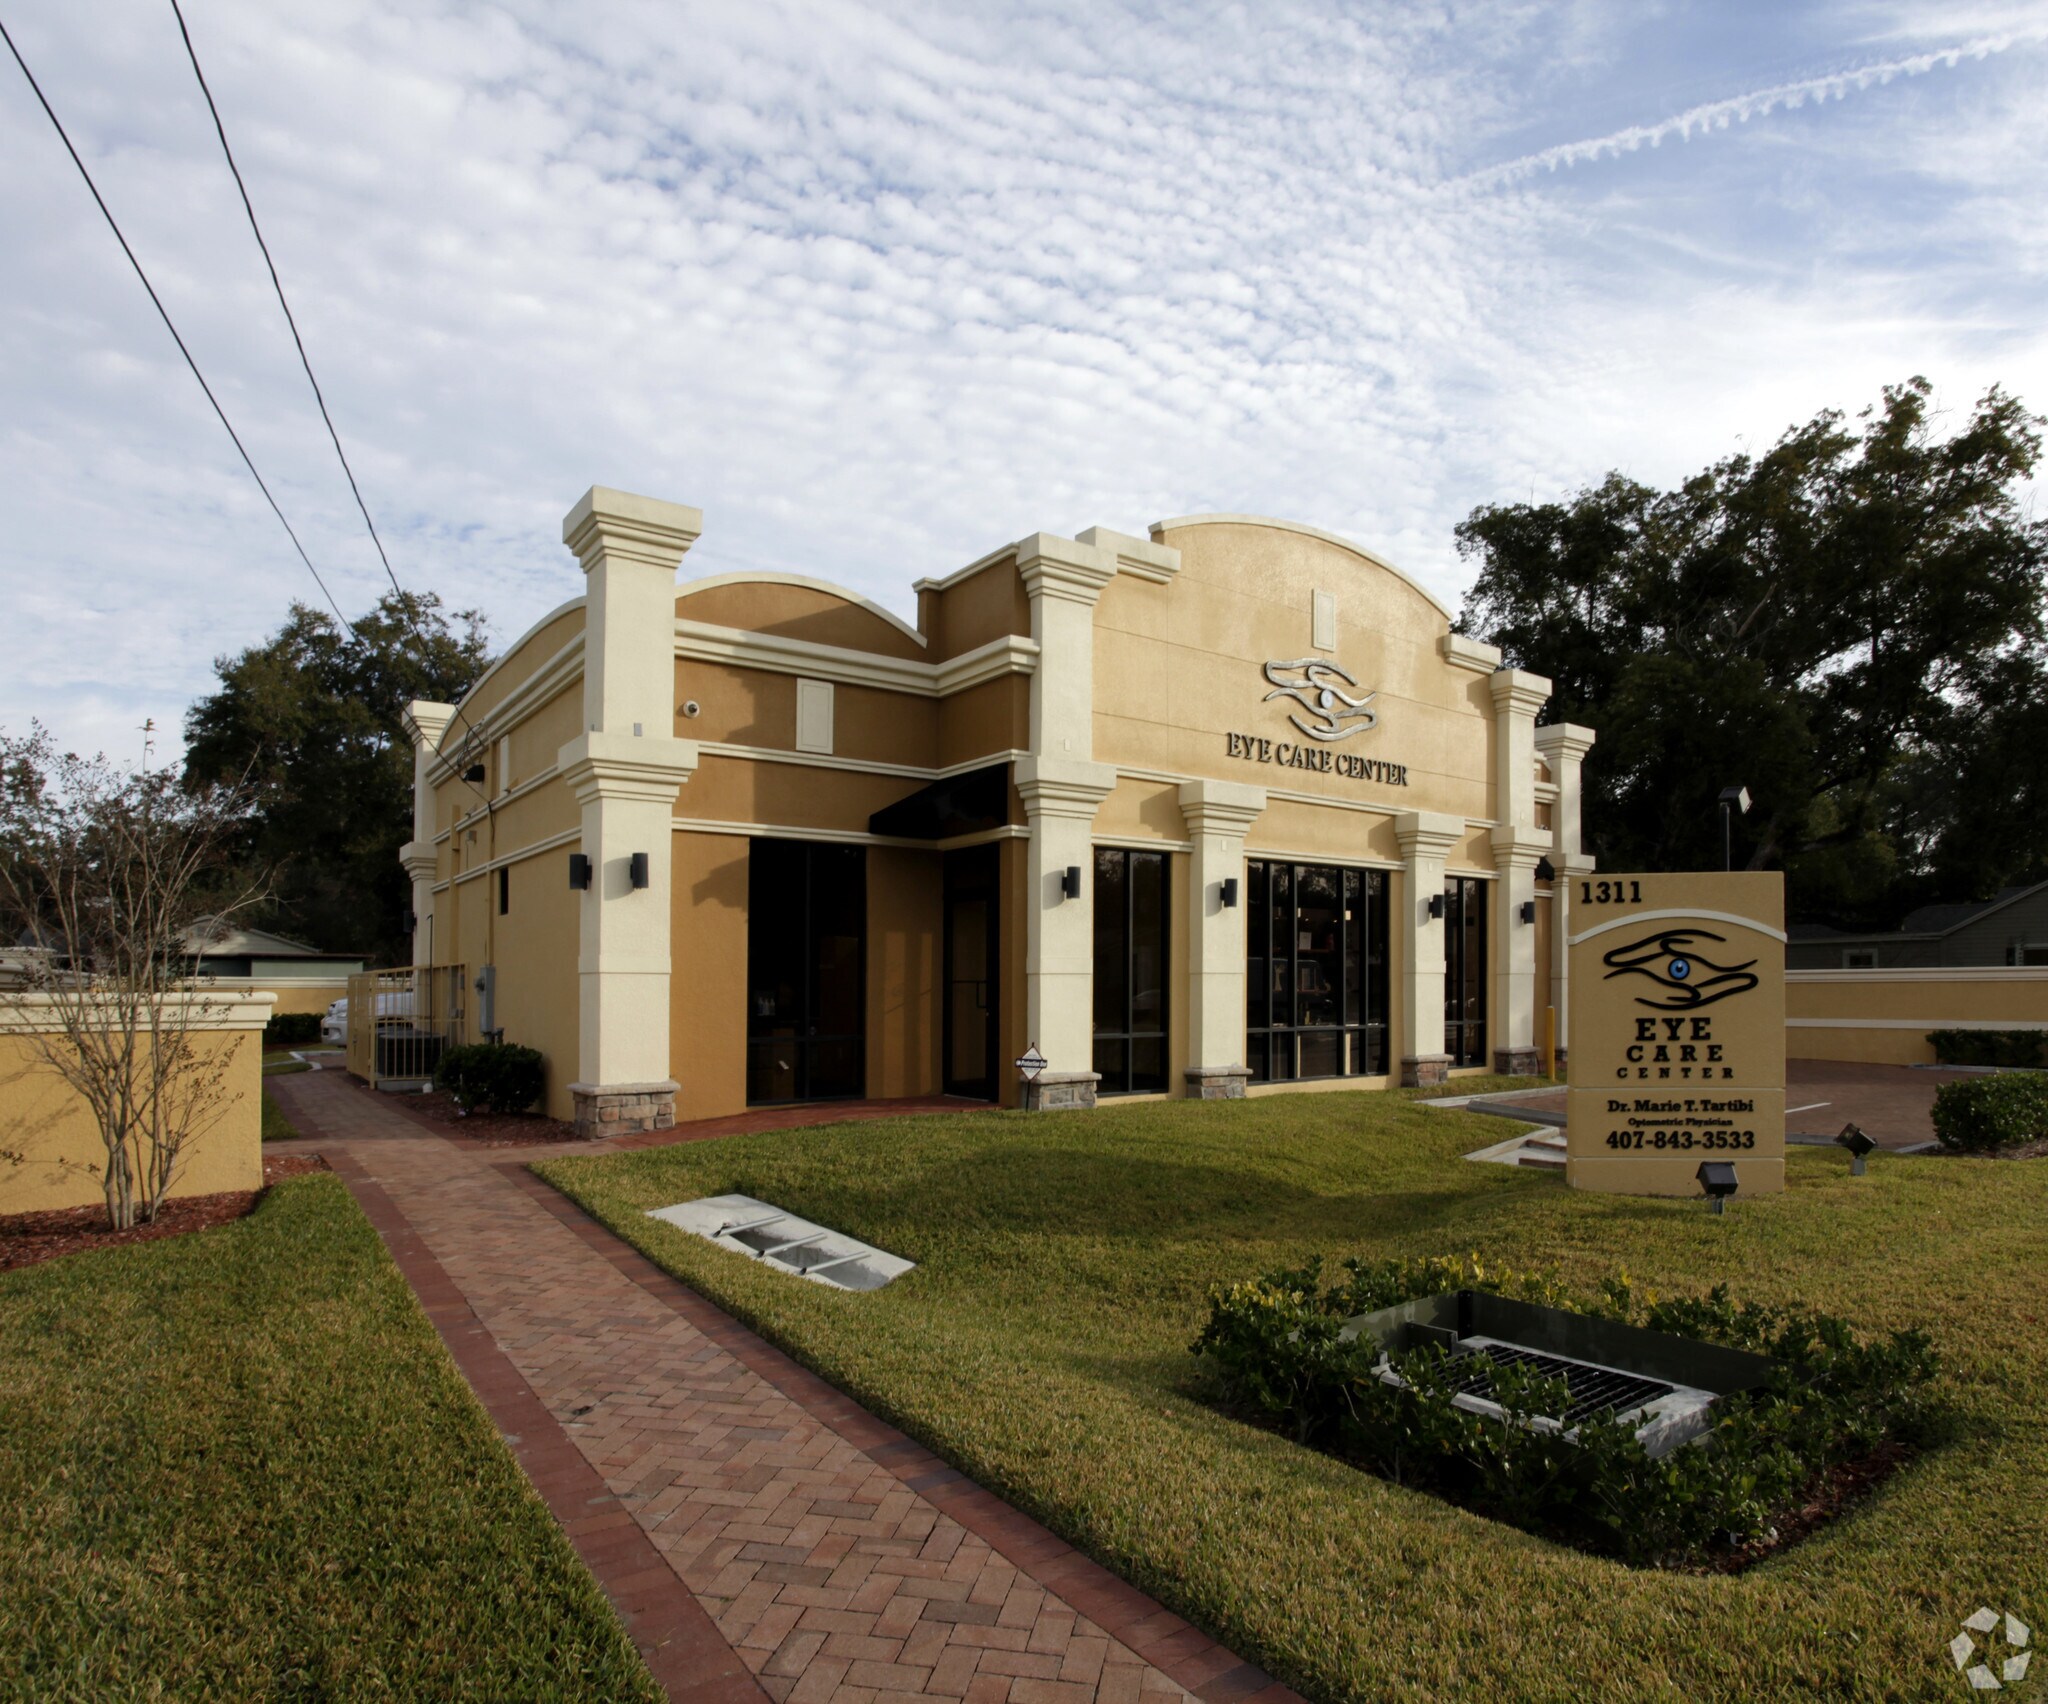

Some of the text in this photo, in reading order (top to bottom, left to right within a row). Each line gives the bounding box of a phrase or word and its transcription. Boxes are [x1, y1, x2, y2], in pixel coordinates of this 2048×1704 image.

[1226, 731, 1410, 787] EYE CARE CENTER
[1581, 881, 1642, 905] 1311
[1635, 1017, 1711, 1042] EYE
[1626, 1044, 1723, 1063] CARE
[1616, 1067, 1733, 1079] CENTER
[1607, 1099, 1754, 1113] Dr. Marie T. Tartibi
[1627, 1117, 1733, 1128] Optometric Physician
[1605, 1130, 1755, 1150] 407-843-3533
